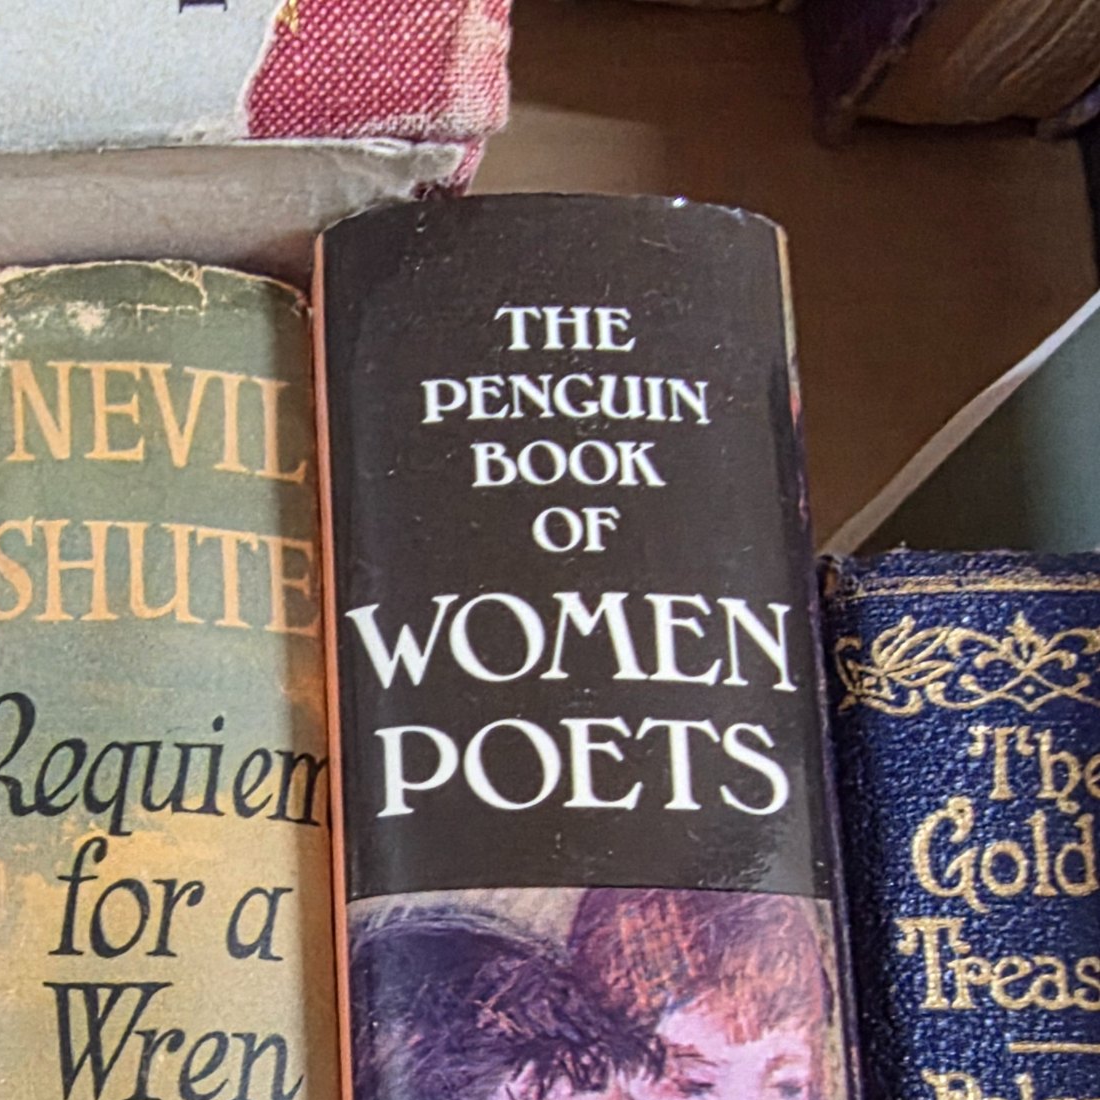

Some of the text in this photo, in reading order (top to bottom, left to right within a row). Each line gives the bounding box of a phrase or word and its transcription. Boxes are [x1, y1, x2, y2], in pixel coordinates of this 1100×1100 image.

[494, 306, 637, 352] THE
[5, 359, 307, 483] NEVIL
[420, 373, 712, 424] PENGUIN
[470, 440, 666, 488] BOOK
[532, 505, 622, 552] OF
[344, 591, 797, 692] WOMEN
[374, 717, 790, 817] POETS
[48, 835, 293, 962] for a
